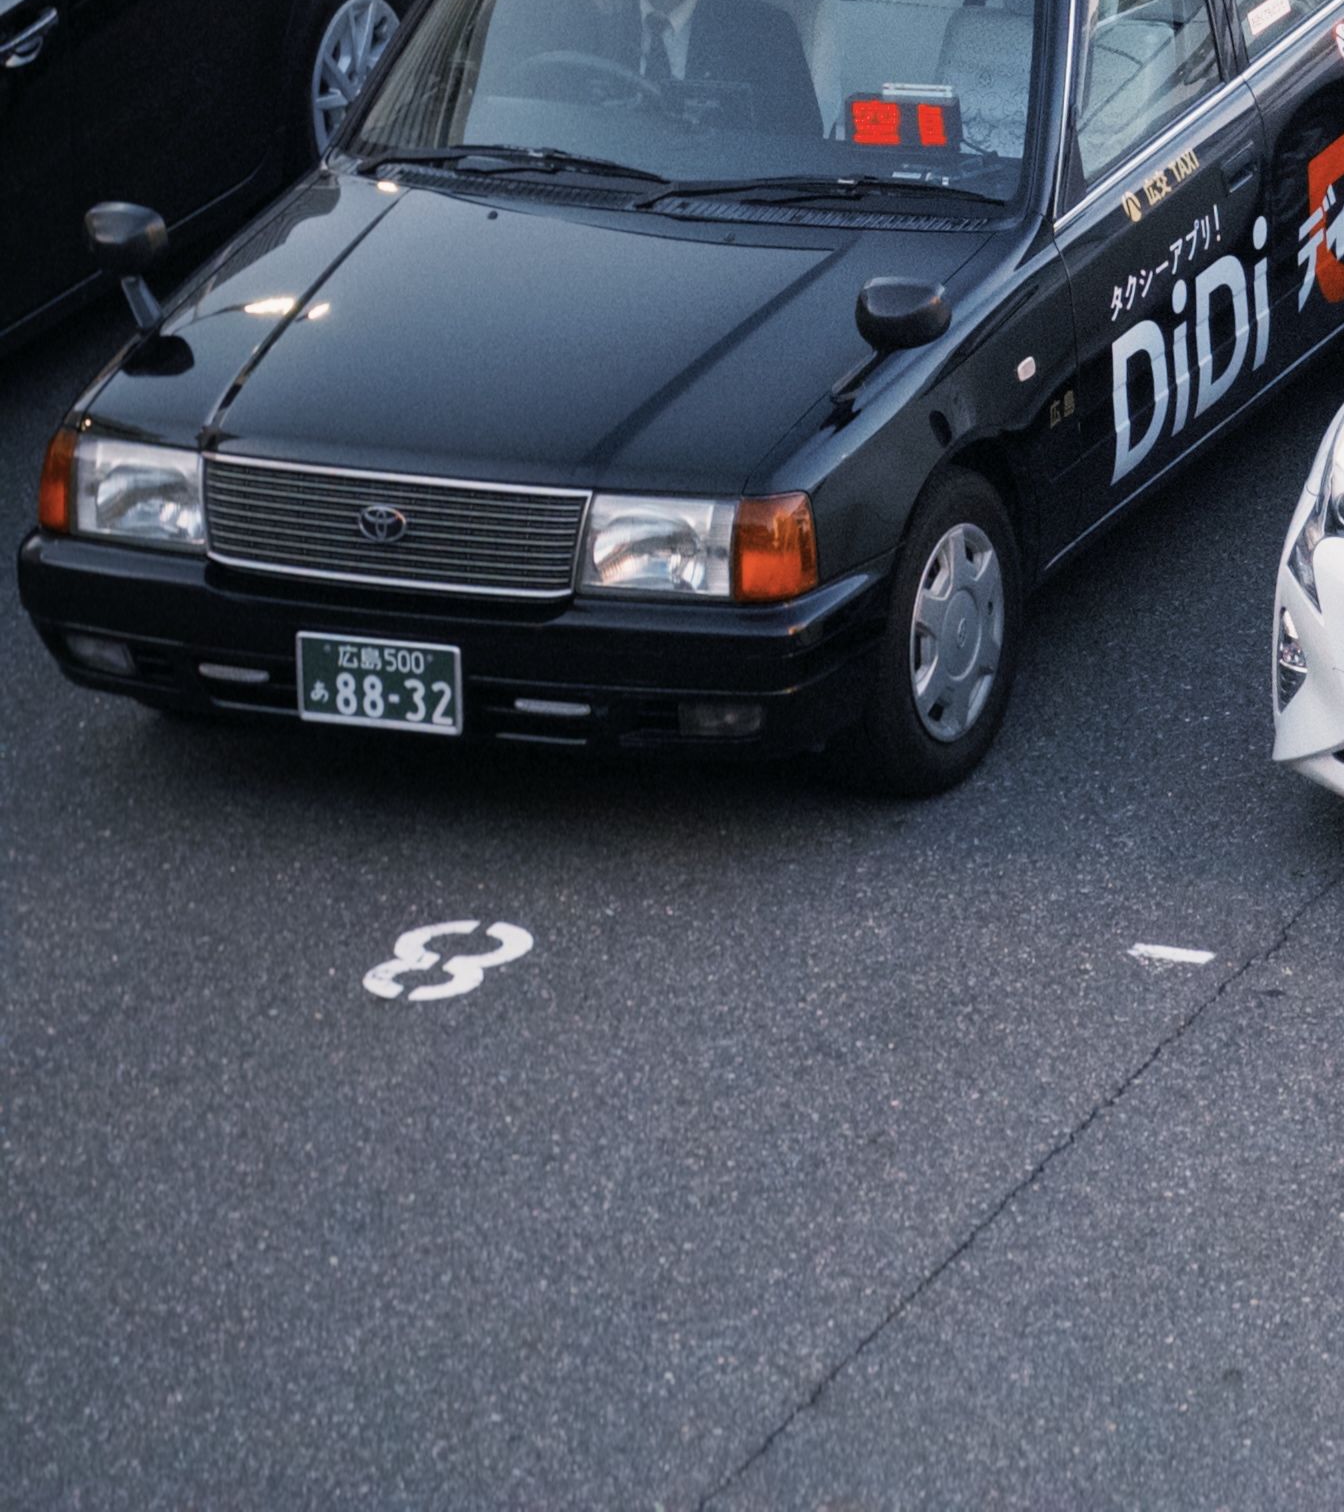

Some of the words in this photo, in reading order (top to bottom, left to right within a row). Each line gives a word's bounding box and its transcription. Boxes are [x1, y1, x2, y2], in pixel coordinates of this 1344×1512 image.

[1168, 148, 1200, 183] TAXI
[1110, 215, 1270, 487] DiDi
[337, 645, 425, 675] 広島500
[310, 679, 330, 704] あ
[336, 672, 453, 726] 88-32
